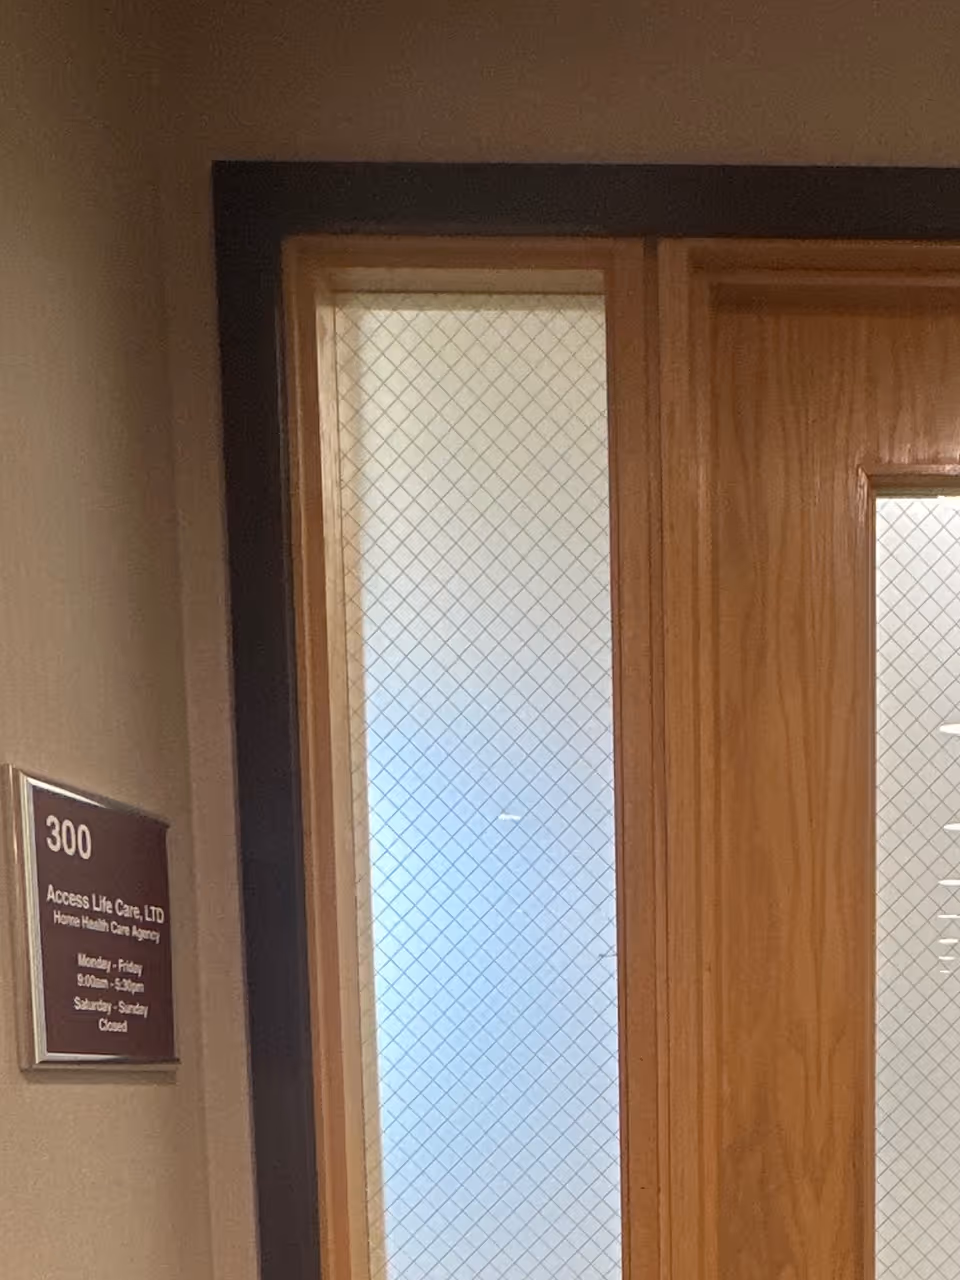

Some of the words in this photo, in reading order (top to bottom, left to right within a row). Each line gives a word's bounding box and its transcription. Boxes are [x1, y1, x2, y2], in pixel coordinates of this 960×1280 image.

[46, 814, 92, 860] 300
[46, 883, 90, 910] Access
[92, 893, 113, 914] Life
[114, 898, 143, 921] Care,
[144, 905, 165, 923] LTD
[53, 909, 81, 927] Home
[81, 915, 110, 932] Health
[110, 921, 130, 936] Care
[131, 925, 160, 944] Agency
[77, 953, 112, 973] Monday
[118, 958, 143, 977] Friday
[76, 973, 109, 989] 9:00am
[114, 977, 145, 995] 5:30pm
[73, 996, 112, 1015] Saturday
[118, 1000, 149, 1018] Sunday
[98, 1017, 128, 1033] Closed
